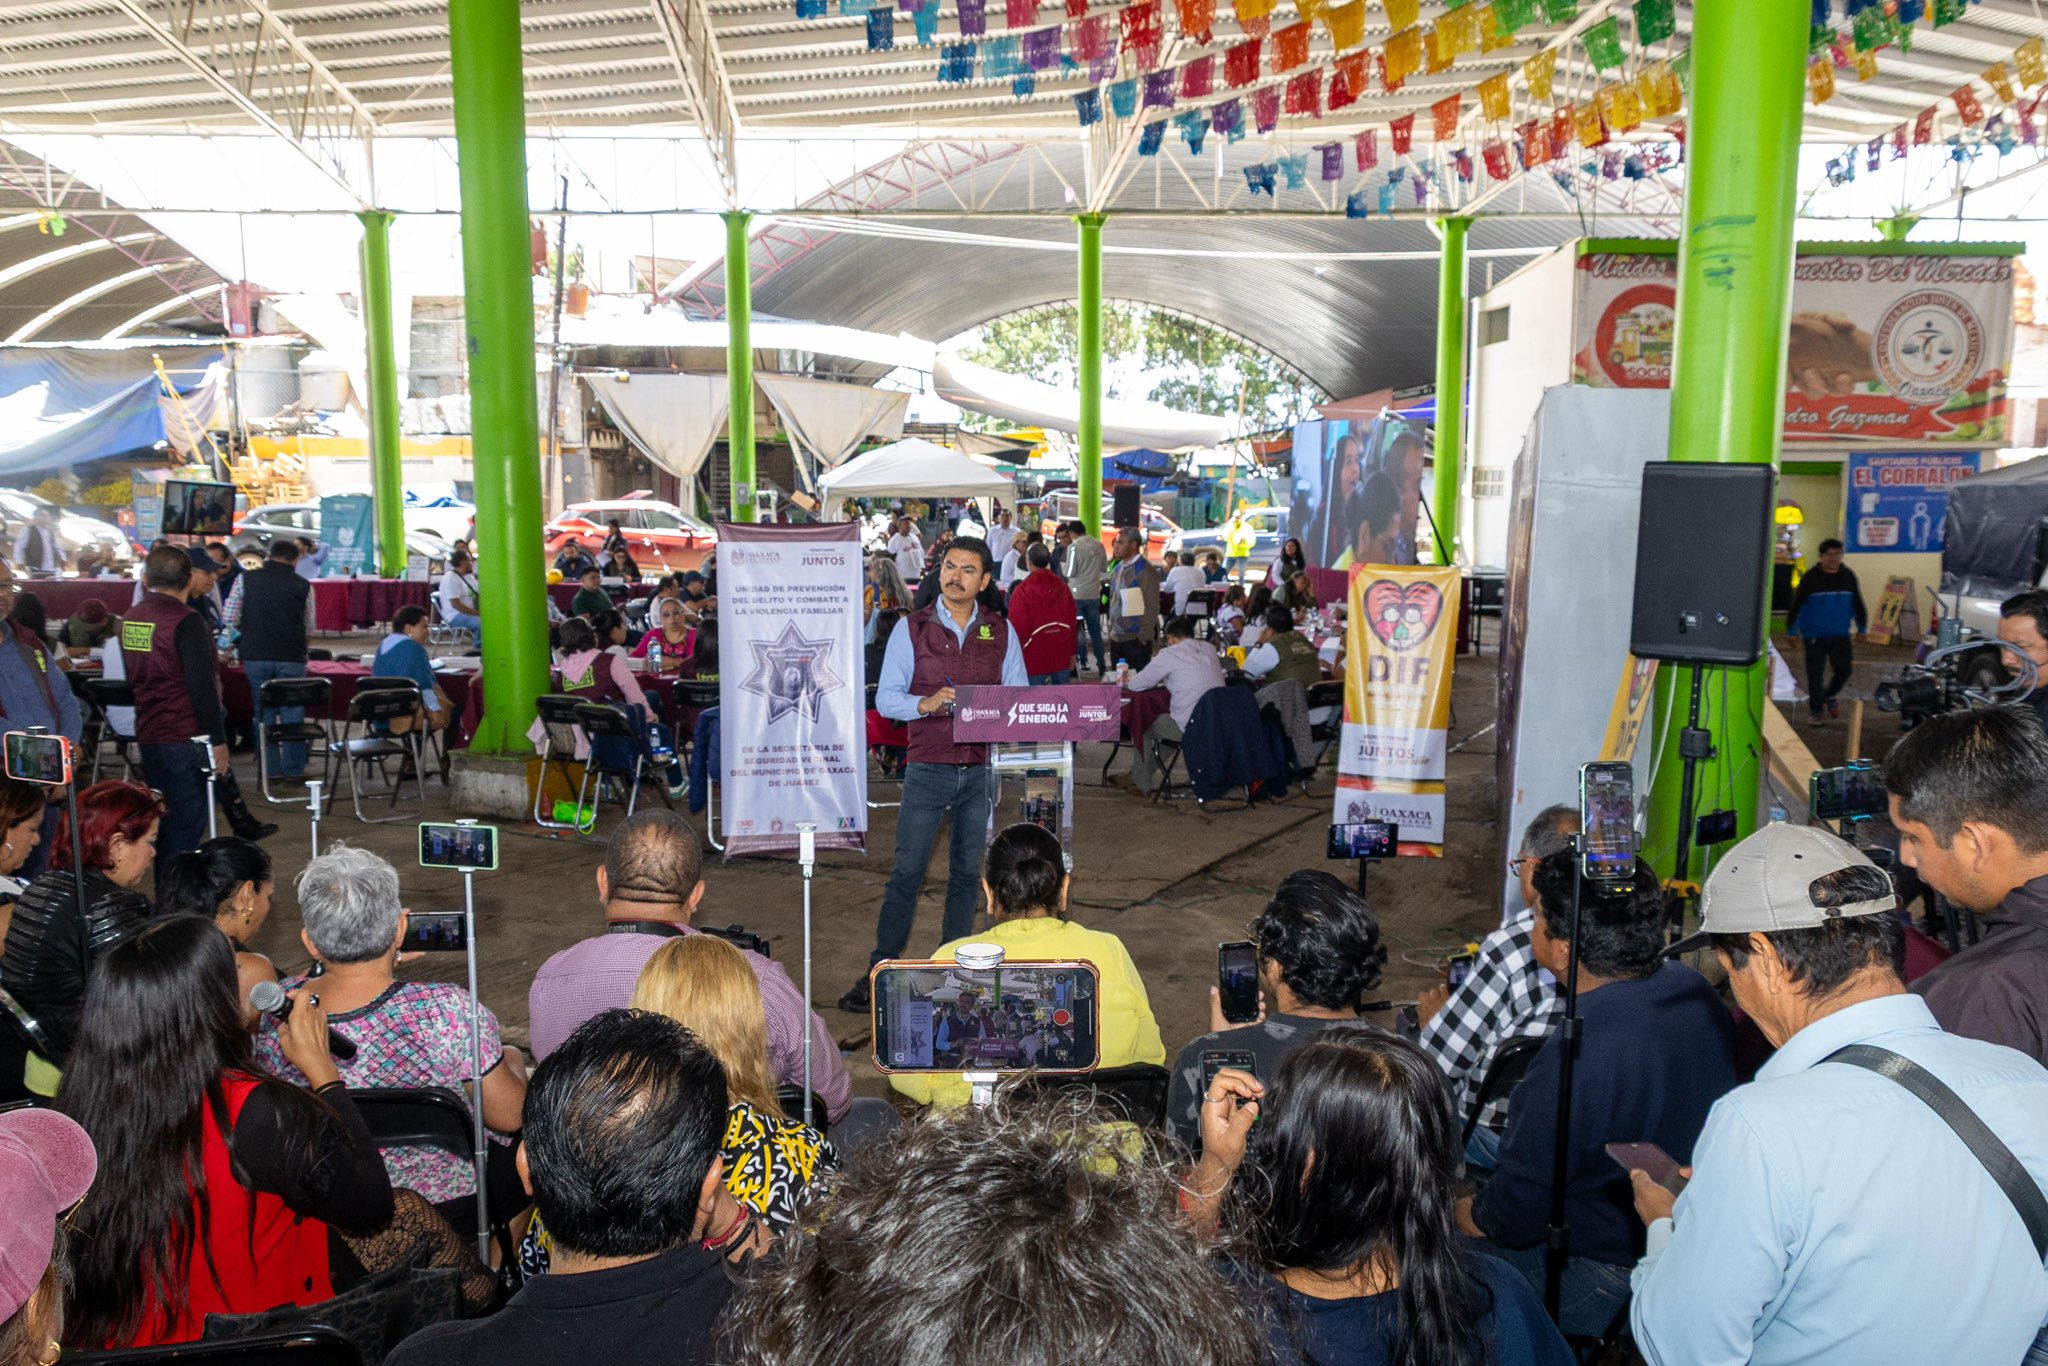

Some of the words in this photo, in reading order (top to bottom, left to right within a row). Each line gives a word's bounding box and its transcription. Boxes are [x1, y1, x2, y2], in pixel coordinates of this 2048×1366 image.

[1591, 254, 1667, 278] Unidos
[1794, 258, 1863, 281] nestar
[1868, 256, 1911, 282] Del
[1914, 255, 2012, 283] Mercado
[1899, 381, 1951, 397] Oaxaca
[1854, 466, 1876, 487] EL
[801, 557, 845, 566] JUNTOS
[735, 585, 770, 593] UNDAD
[787, 584, 846, 592] PREVENCIÓN
[1368, 655, 1430, 685] DIF
[1018, 703, 1035, 713] QUE
[1037, 703, 1056, 712] SIGA
[1057, 703, 1069, 712] LA
[1018, 712, 1068, 723] ENERGÍA
[772, 744, 830, 753] SECRTARIA
[1358, 745, 1415, 759] JUNTOS
[744, 757, 798, 765] SEGURIDAD
[752, 769, 800, 777] MUNICIPIO
[819, 767, 857, 775] OAXACA
[1380, 807, 1432, 820] OAXACA
